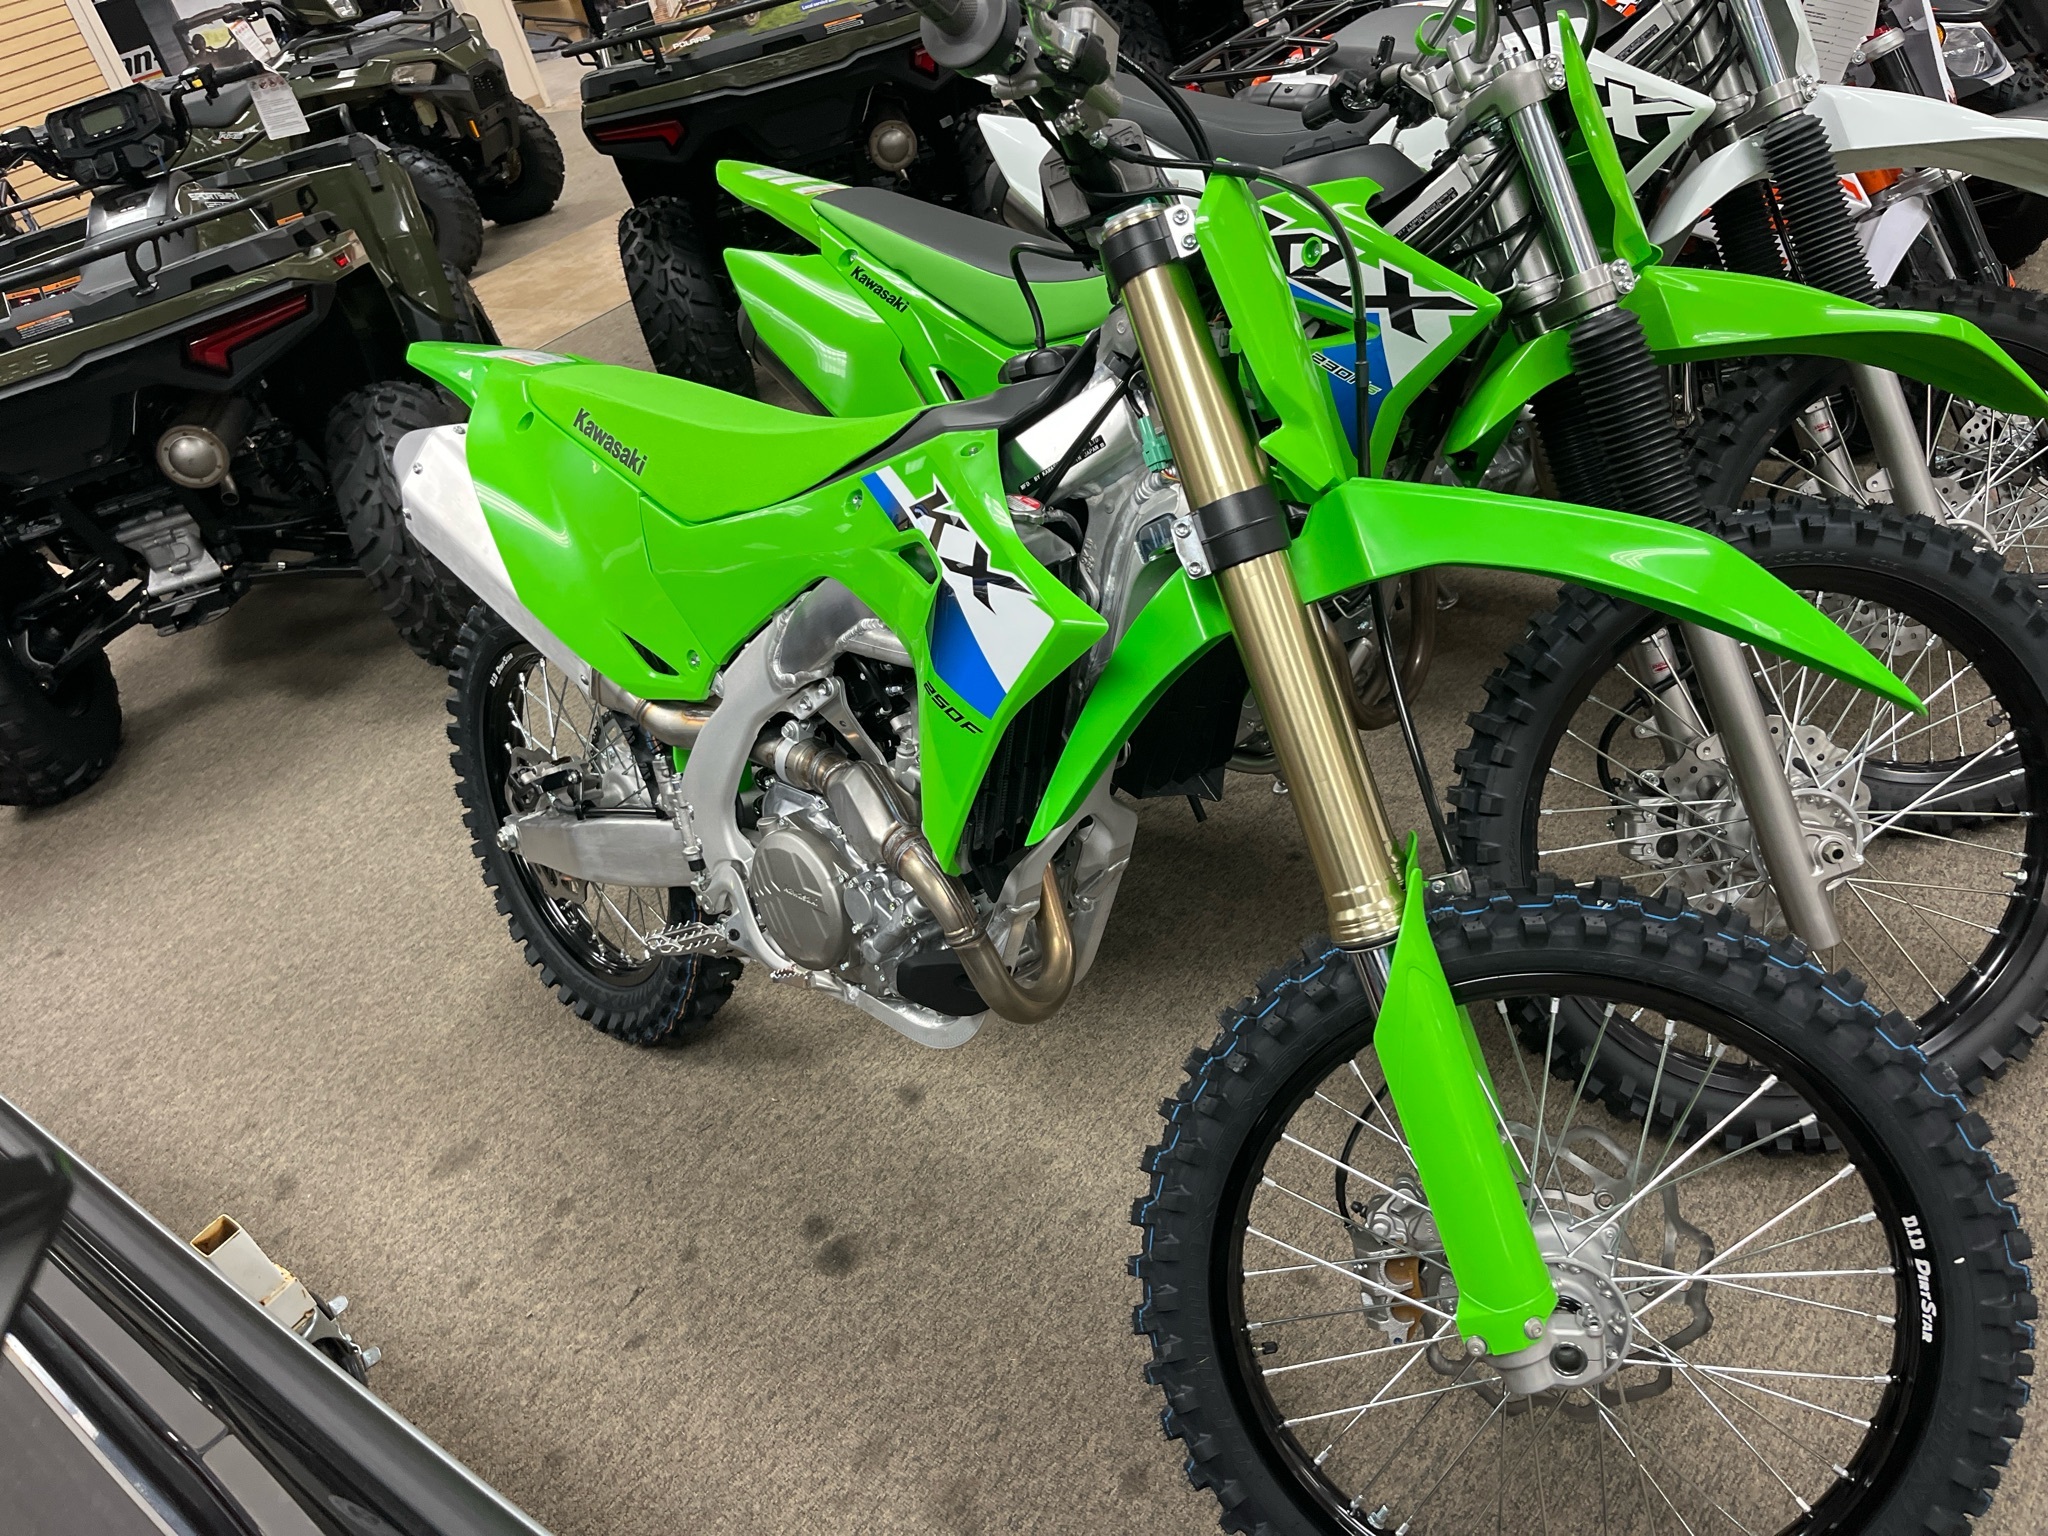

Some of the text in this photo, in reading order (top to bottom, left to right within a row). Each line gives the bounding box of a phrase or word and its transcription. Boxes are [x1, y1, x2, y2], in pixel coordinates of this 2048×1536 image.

[672, 34, 711, 50] POLARIS
[850, 264, 911, 314] Kawasaki
[572, 407, 648, 477] Kawasaki
[908, 482, 1034, 617] KX
[923, 680, 985, 735] 250F
